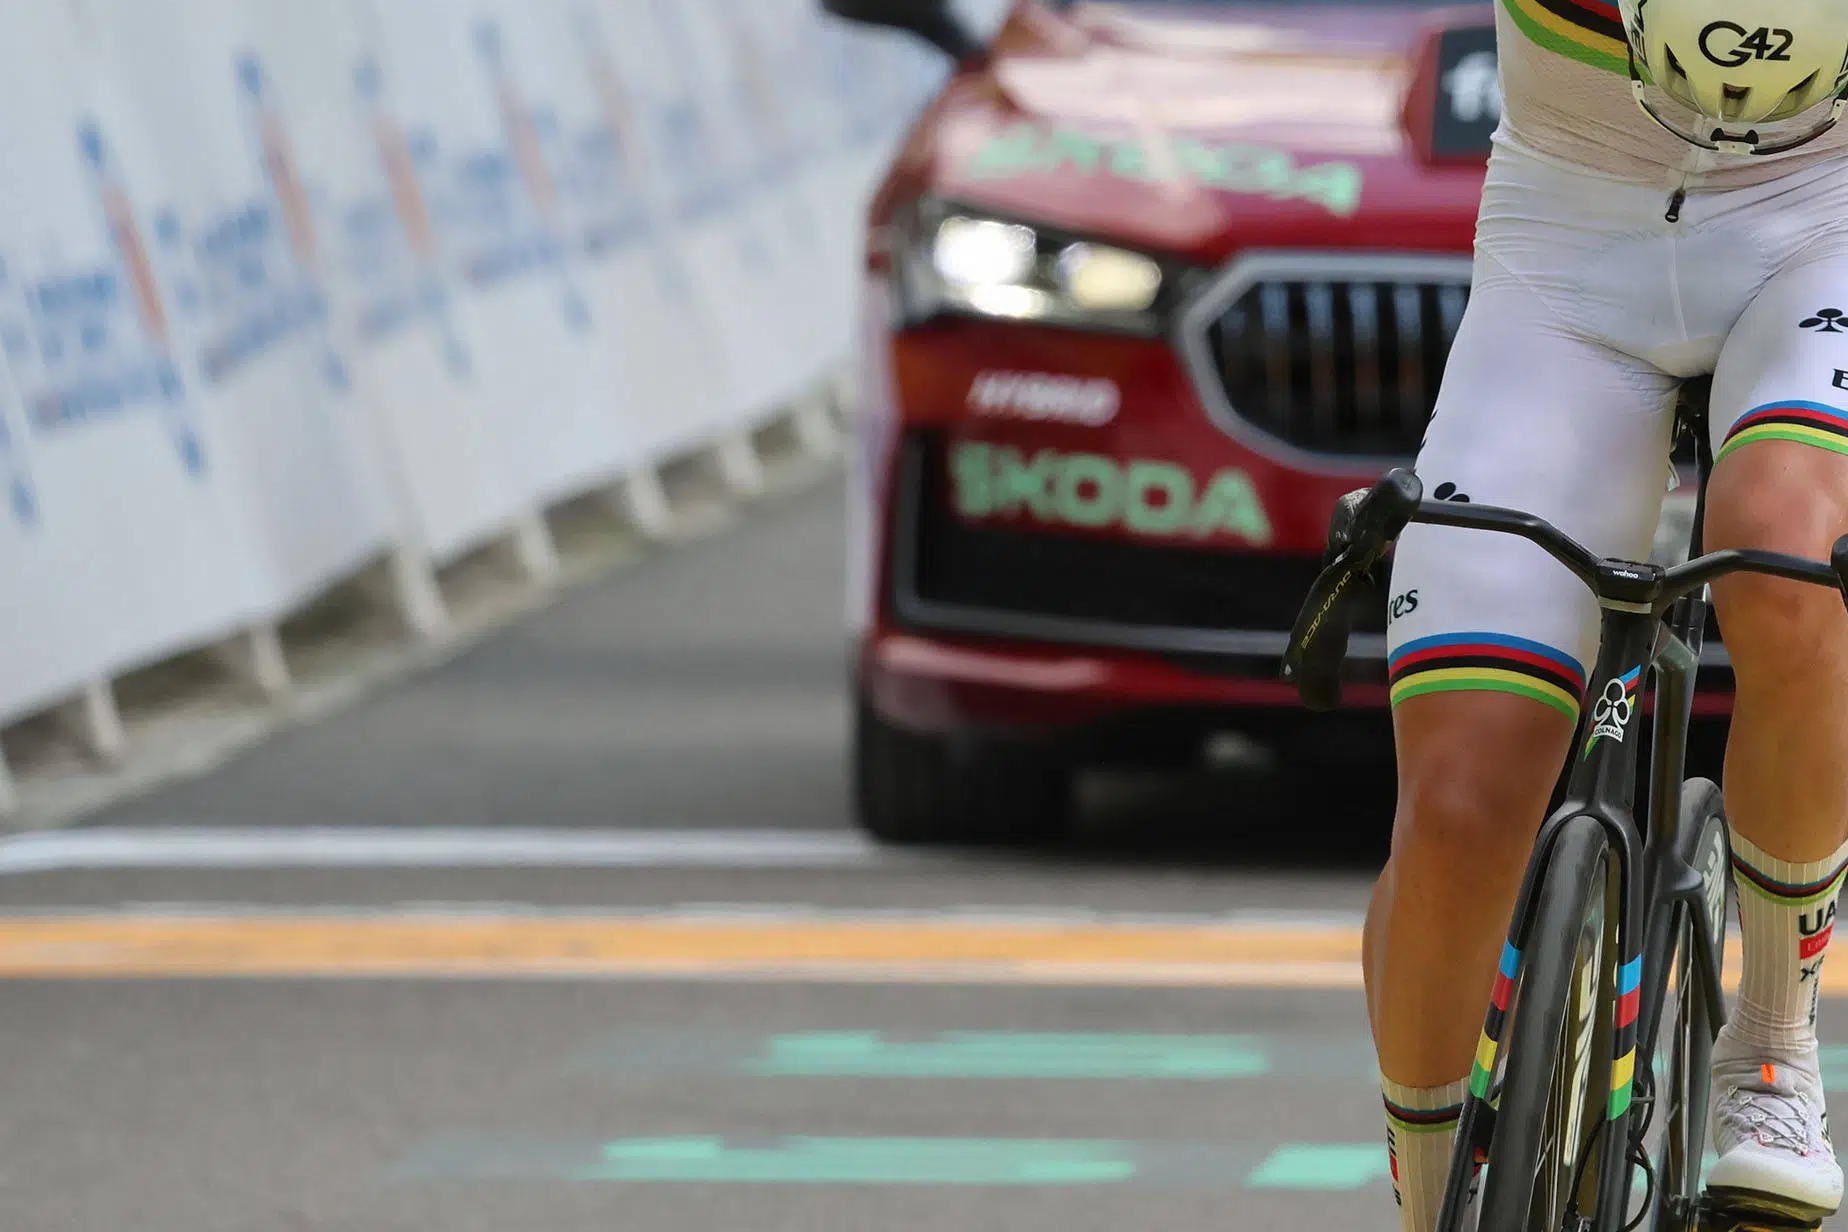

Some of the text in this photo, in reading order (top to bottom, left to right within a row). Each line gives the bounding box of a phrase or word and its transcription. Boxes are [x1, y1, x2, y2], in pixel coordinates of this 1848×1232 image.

[1698, 20, 1794, 68] G42
[1612, 569, 1639, 579] wahoo
[1594, 726, 1623, 738] COLNAGO
[1799, 900, 1836, 936] UA
